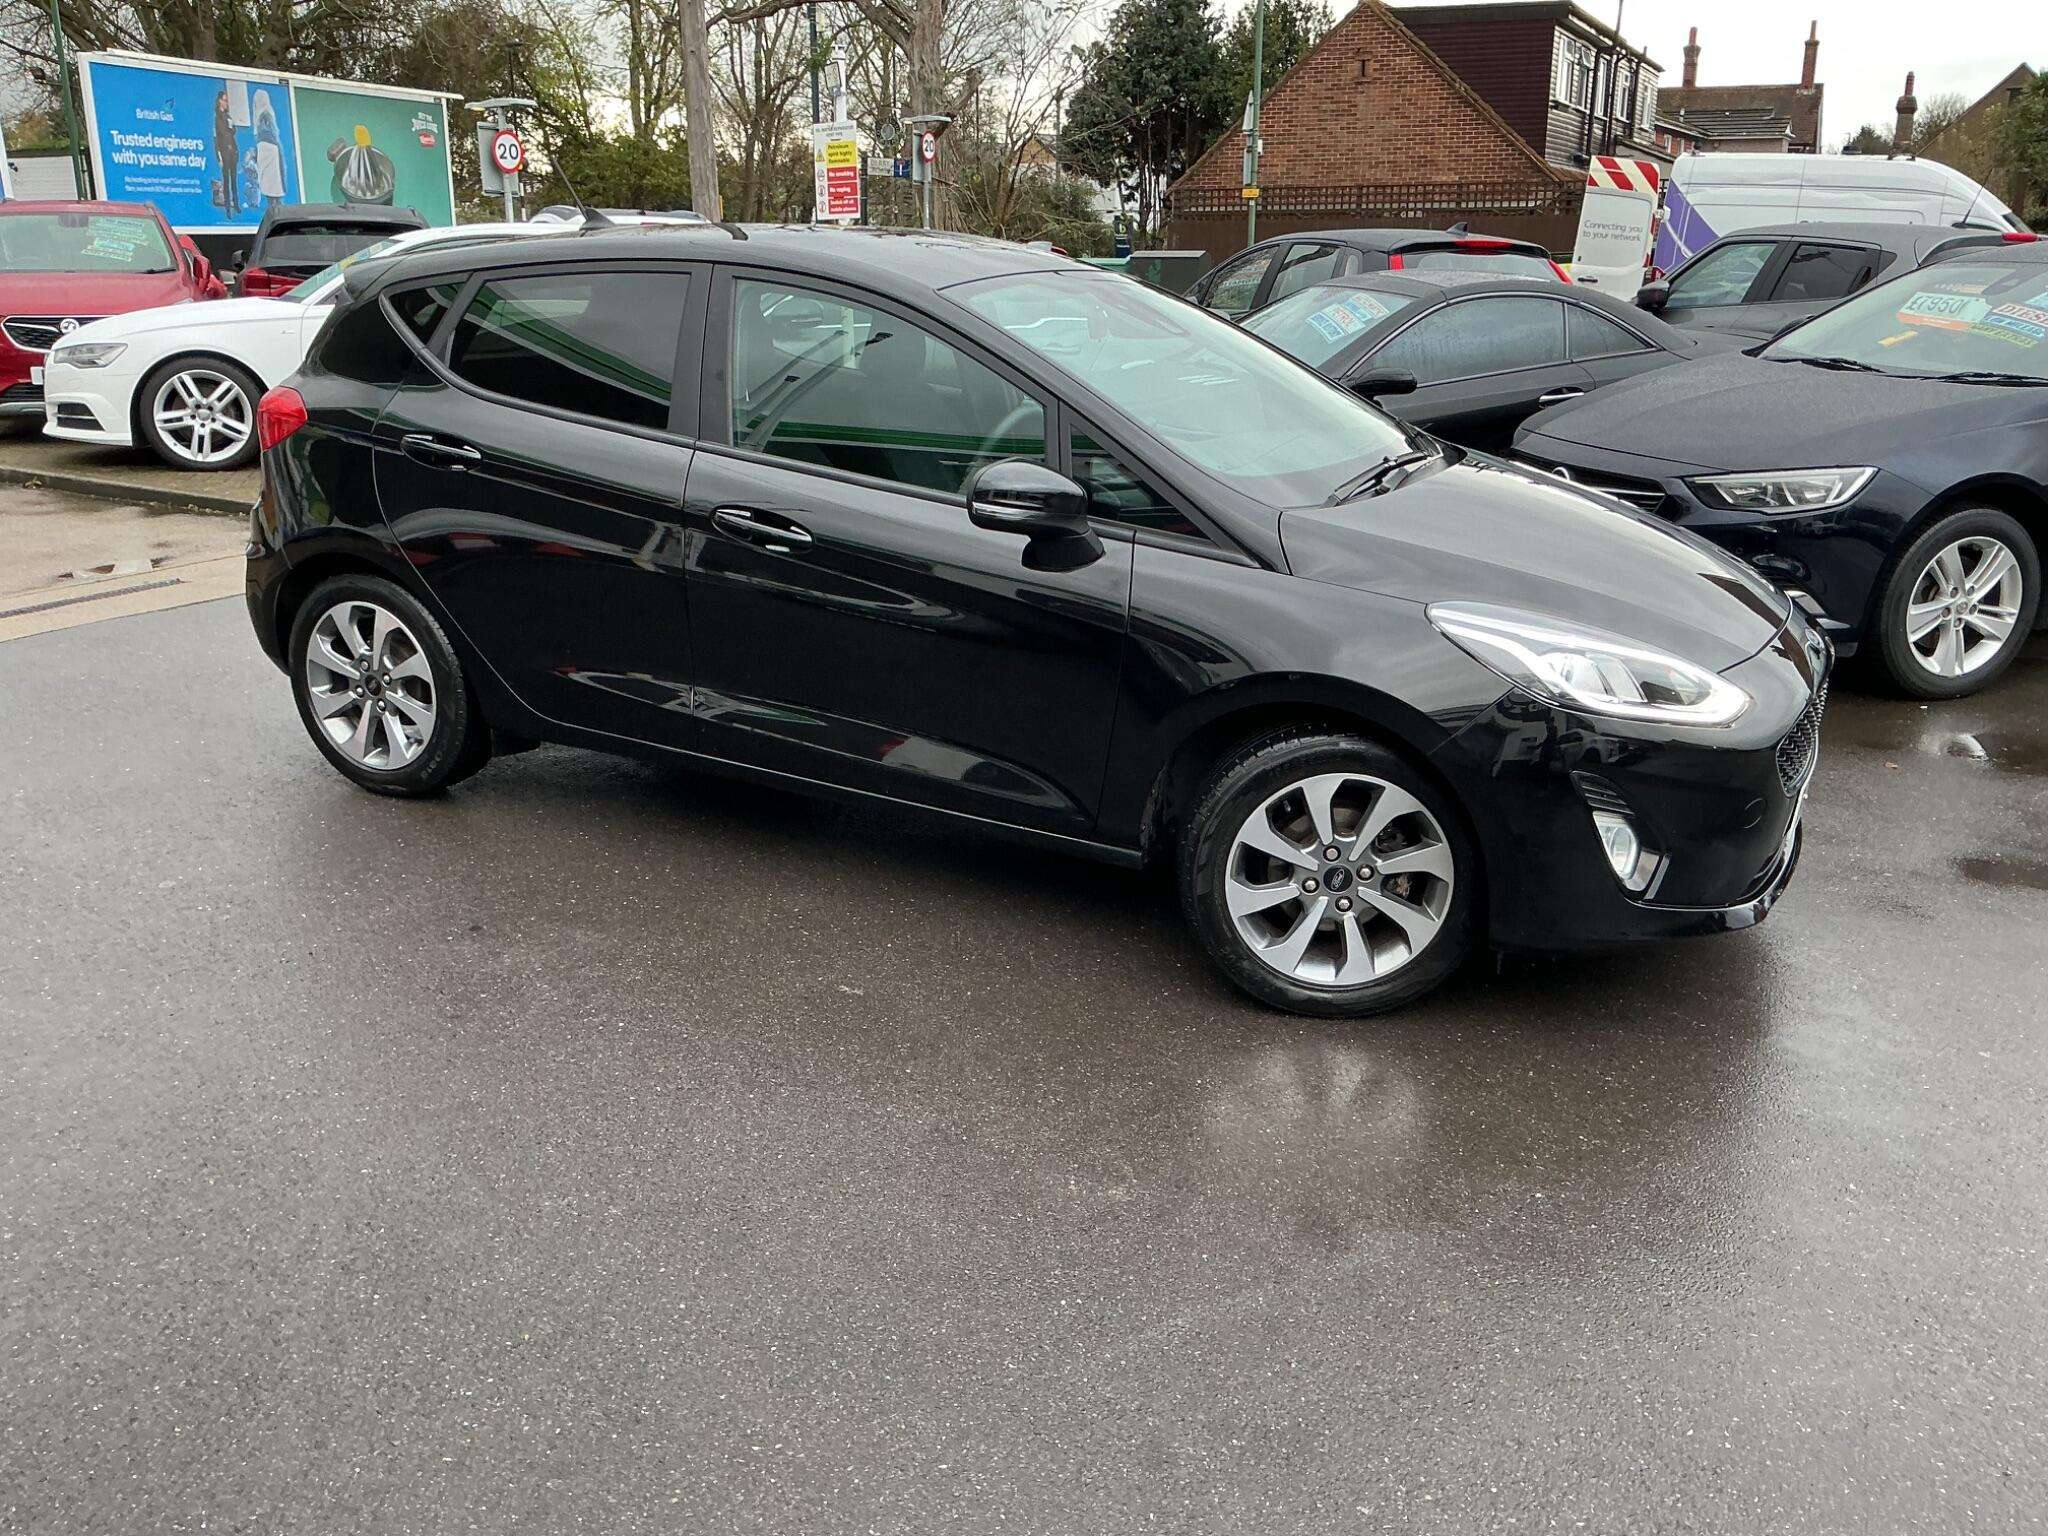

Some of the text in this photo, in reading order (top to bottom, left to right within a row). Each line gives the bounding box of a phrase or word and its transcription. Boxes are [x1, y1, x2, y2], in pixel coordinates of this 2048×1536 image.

[136, 108, 174, 121] British Gas
[110, 130, 204, 152] Trusted engineers
[924, 139, 934, 152] 20
[498, 143, 519, 160] 20
[112, 149, 206, 170] with you same day
[1584, 219, 1643, 234] Connecting you
[1592, 232, 1609, 240] your
[1610, 232, 1641, 241] network
